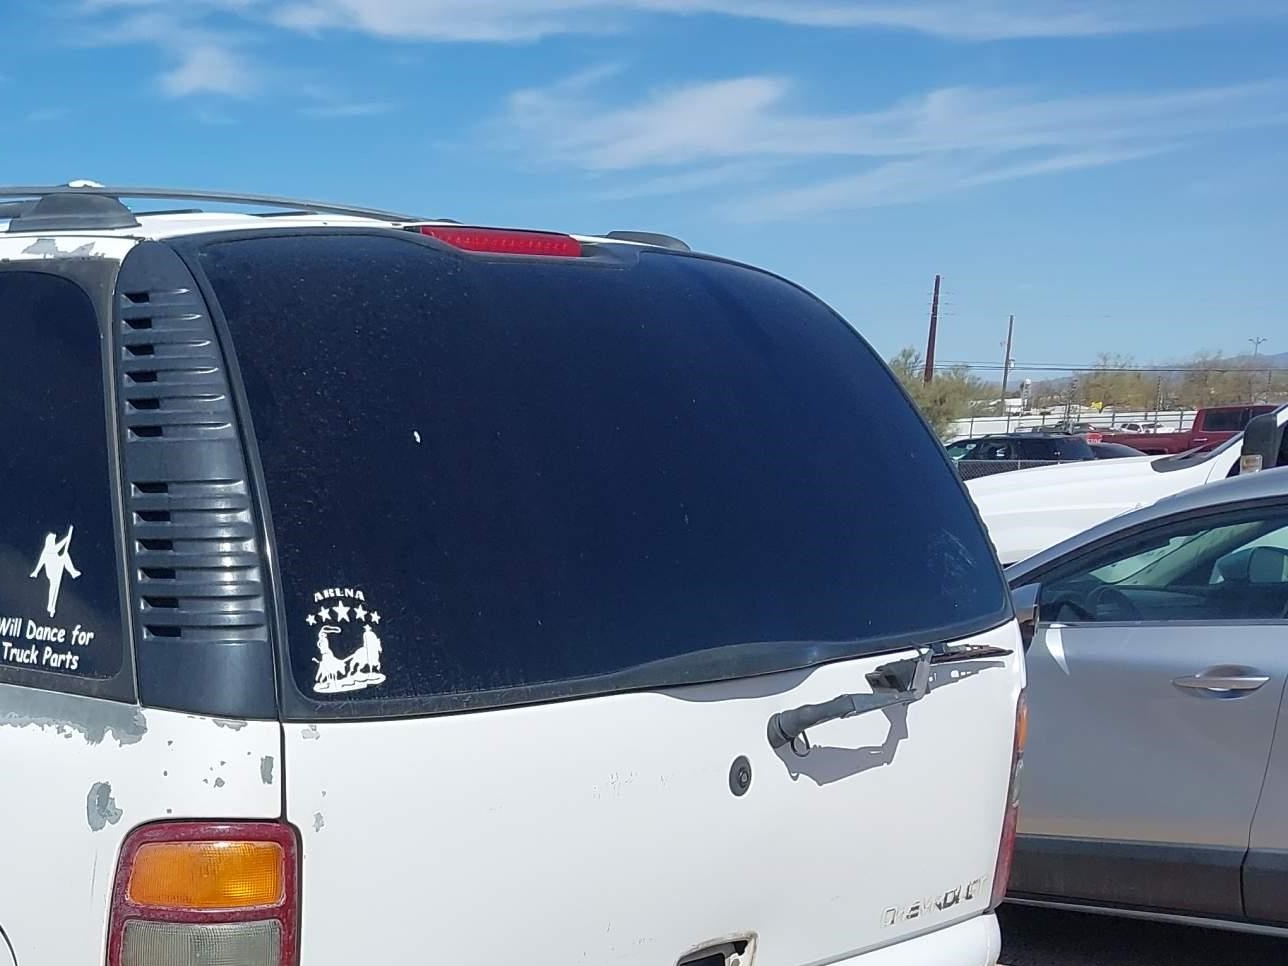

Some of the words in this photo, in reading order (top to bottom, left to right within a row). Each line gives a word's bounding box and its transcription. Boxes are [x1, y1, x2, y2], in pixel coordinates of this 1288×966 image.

[26, 619, 66, 642] Dance
[72, 624, 94, 645] for
[2, 641, 38, 664] Truck
[42, 646, 79, 670] Parts
